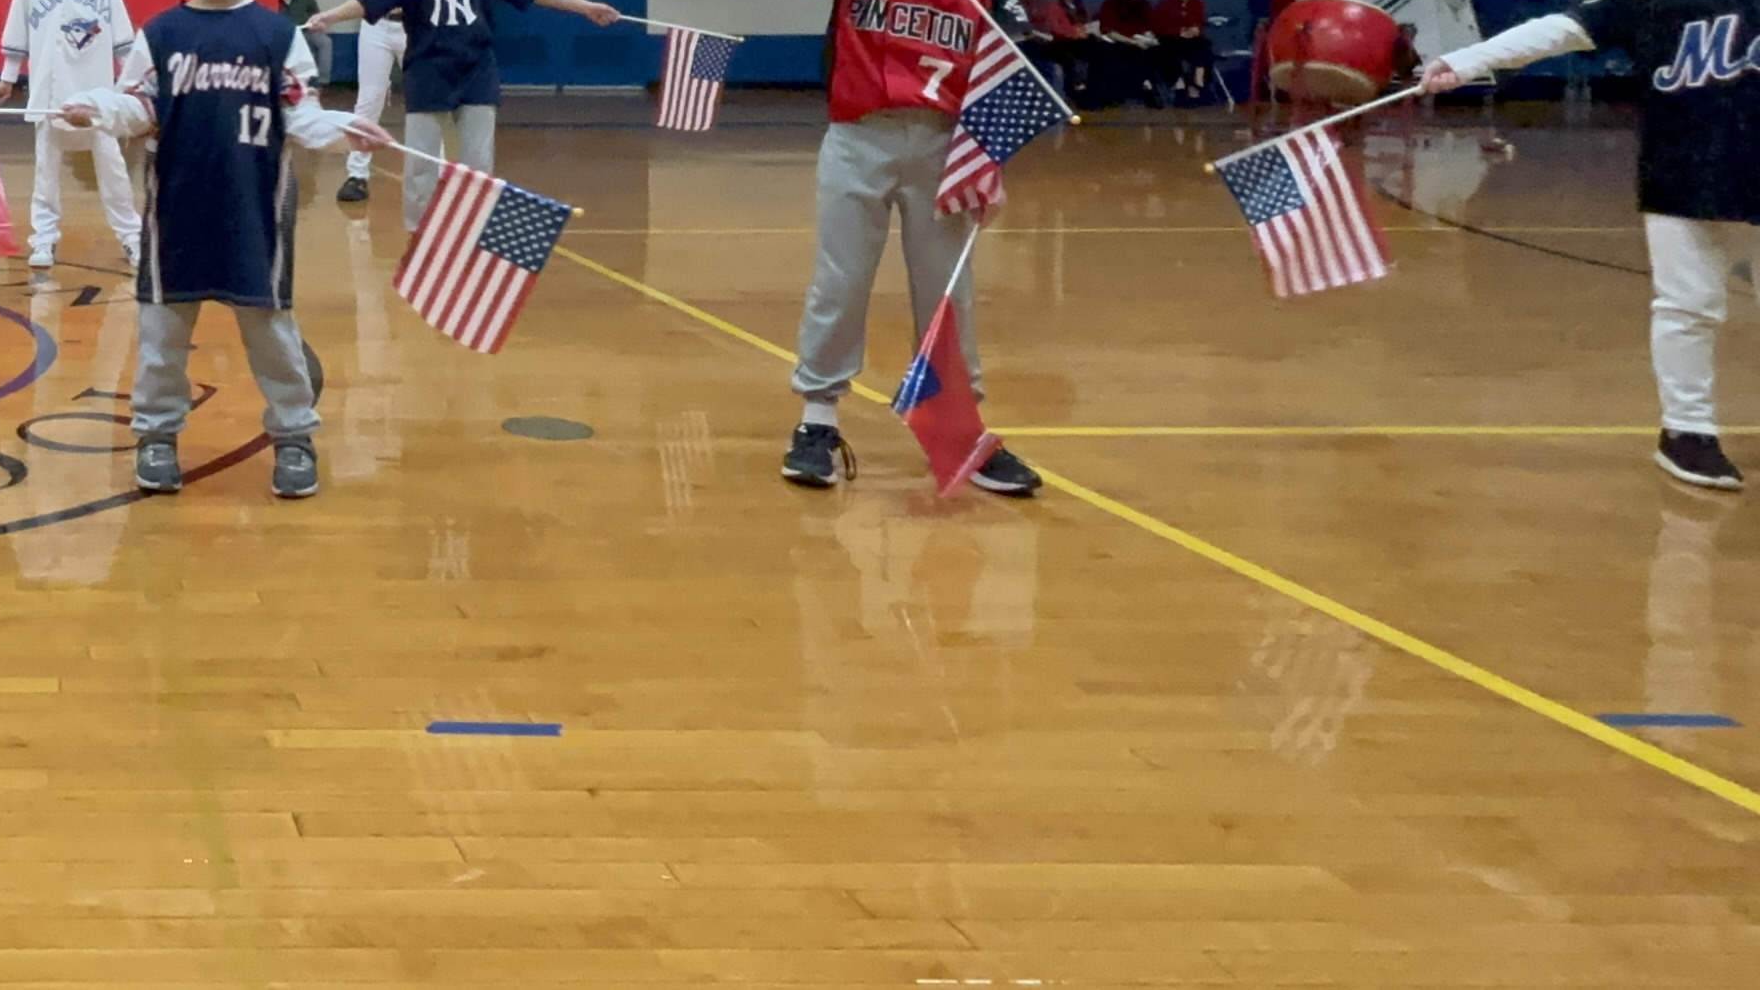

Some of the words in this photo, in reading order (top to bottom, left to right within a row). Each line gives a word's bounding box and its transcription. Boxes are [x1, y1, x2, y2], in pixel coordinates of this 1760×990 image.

[167, 51, 271, 97] Warriors
[918, 55, 954, 102] 7
[238, 104, 272, 147] 17
